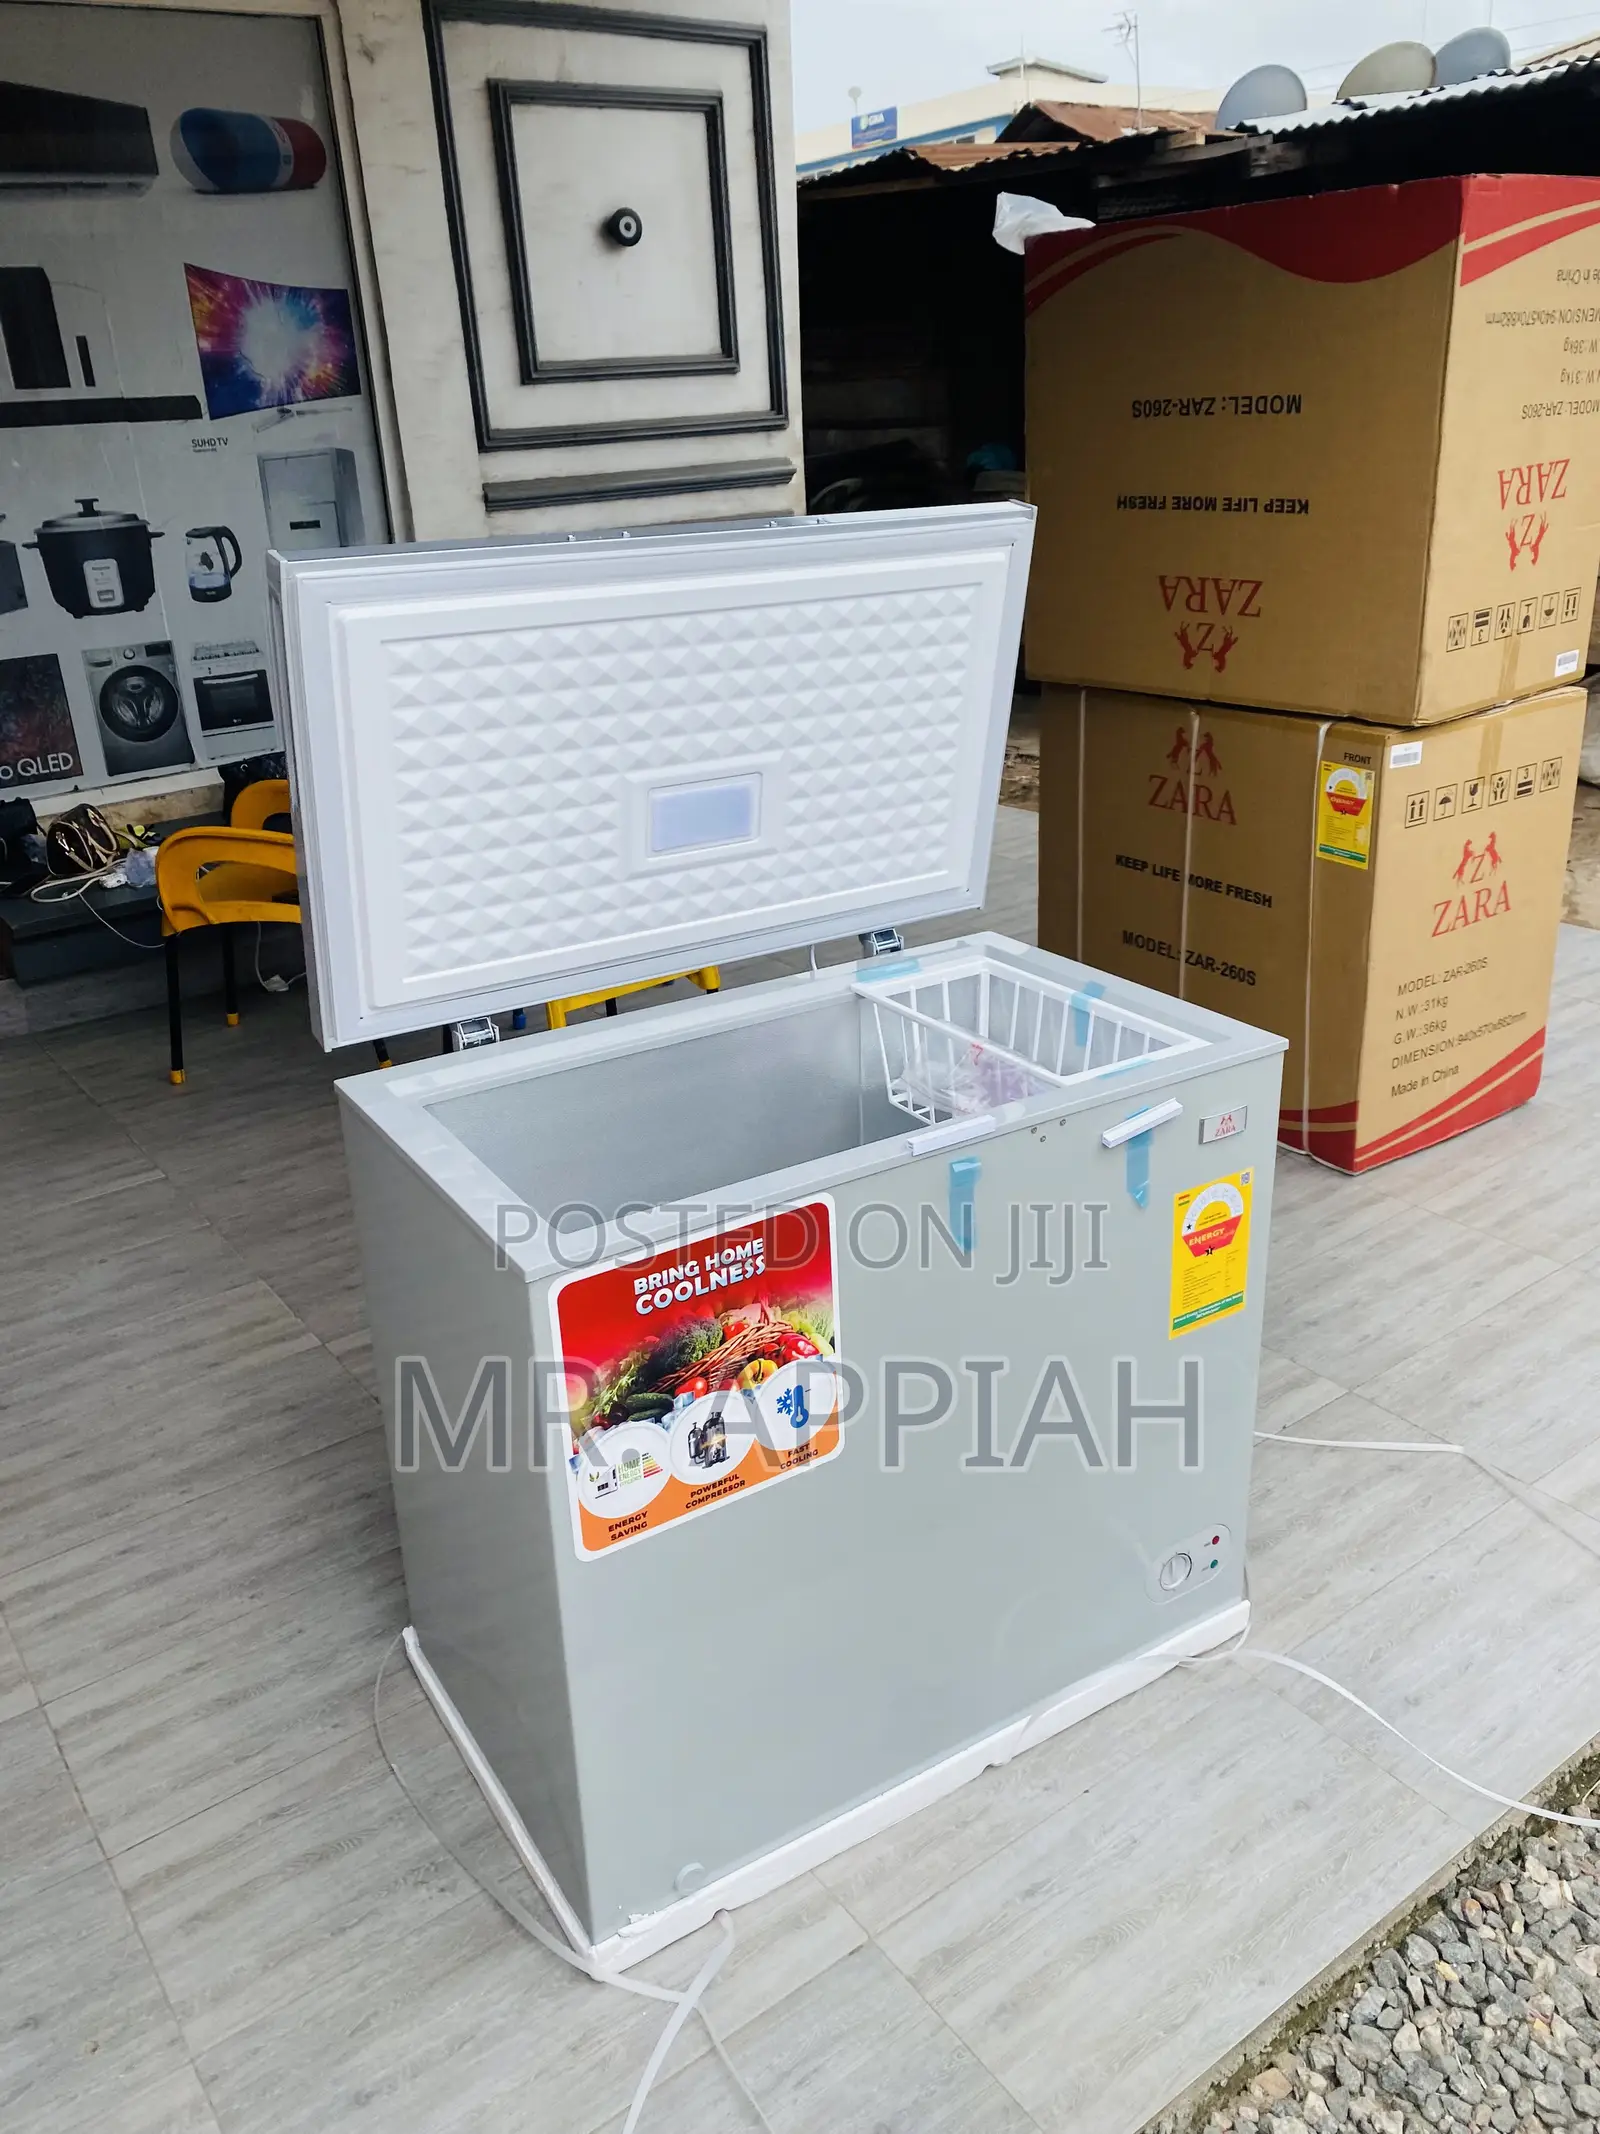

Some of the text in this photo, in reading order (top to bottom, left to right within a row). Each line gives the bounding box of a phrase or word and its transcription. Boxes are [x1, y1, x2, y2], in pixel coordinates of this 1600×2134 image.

[1132, 394, 1302, 418] MODEL: ZAR-260S
[191, 436, 229, 448] SUHD TV
[1497, 458, 1570, 510] ZARA
[1116, 493, 1309, 515] KEEP LIFE MORE FRESH
[1158, 575, 1264, 618] ZARA
[17, 752, 74, 777] QLED
[1343, 752, 1372, 765] FRONT
[1147, 774, 1237, 825] ZARA
[1115, 854, 1149, 873] KEEP
[1152, 862, 1180, 882] LIFE
[1226, 883, 1273, 908] FRESH
[1431, 879, 1512, 937] ZARA
[1122, 929, 1256, 987] MODEL: ZAR-260S
[1397, 974, 1441, 996] MODEL:
[1391, 1064, 1460, 1098] Made in China
[1188, 1227, 1226, 1247] ENERGY
[633, 1237, 764, 1295] BRING HOME
[635, 1254, 766, 1315] COOLNESS
[780, 1448, 819, 1470] COOLING
[787, 1442, 811, 1458] FAST
[685, 1479, 746, 1510] COMPRESSOR
[690, 1473, 740, 1499] POWERFUL
[608, 1510, 649, 1533] ENERGY
[610, 1520, 648, 1542] SAVING
